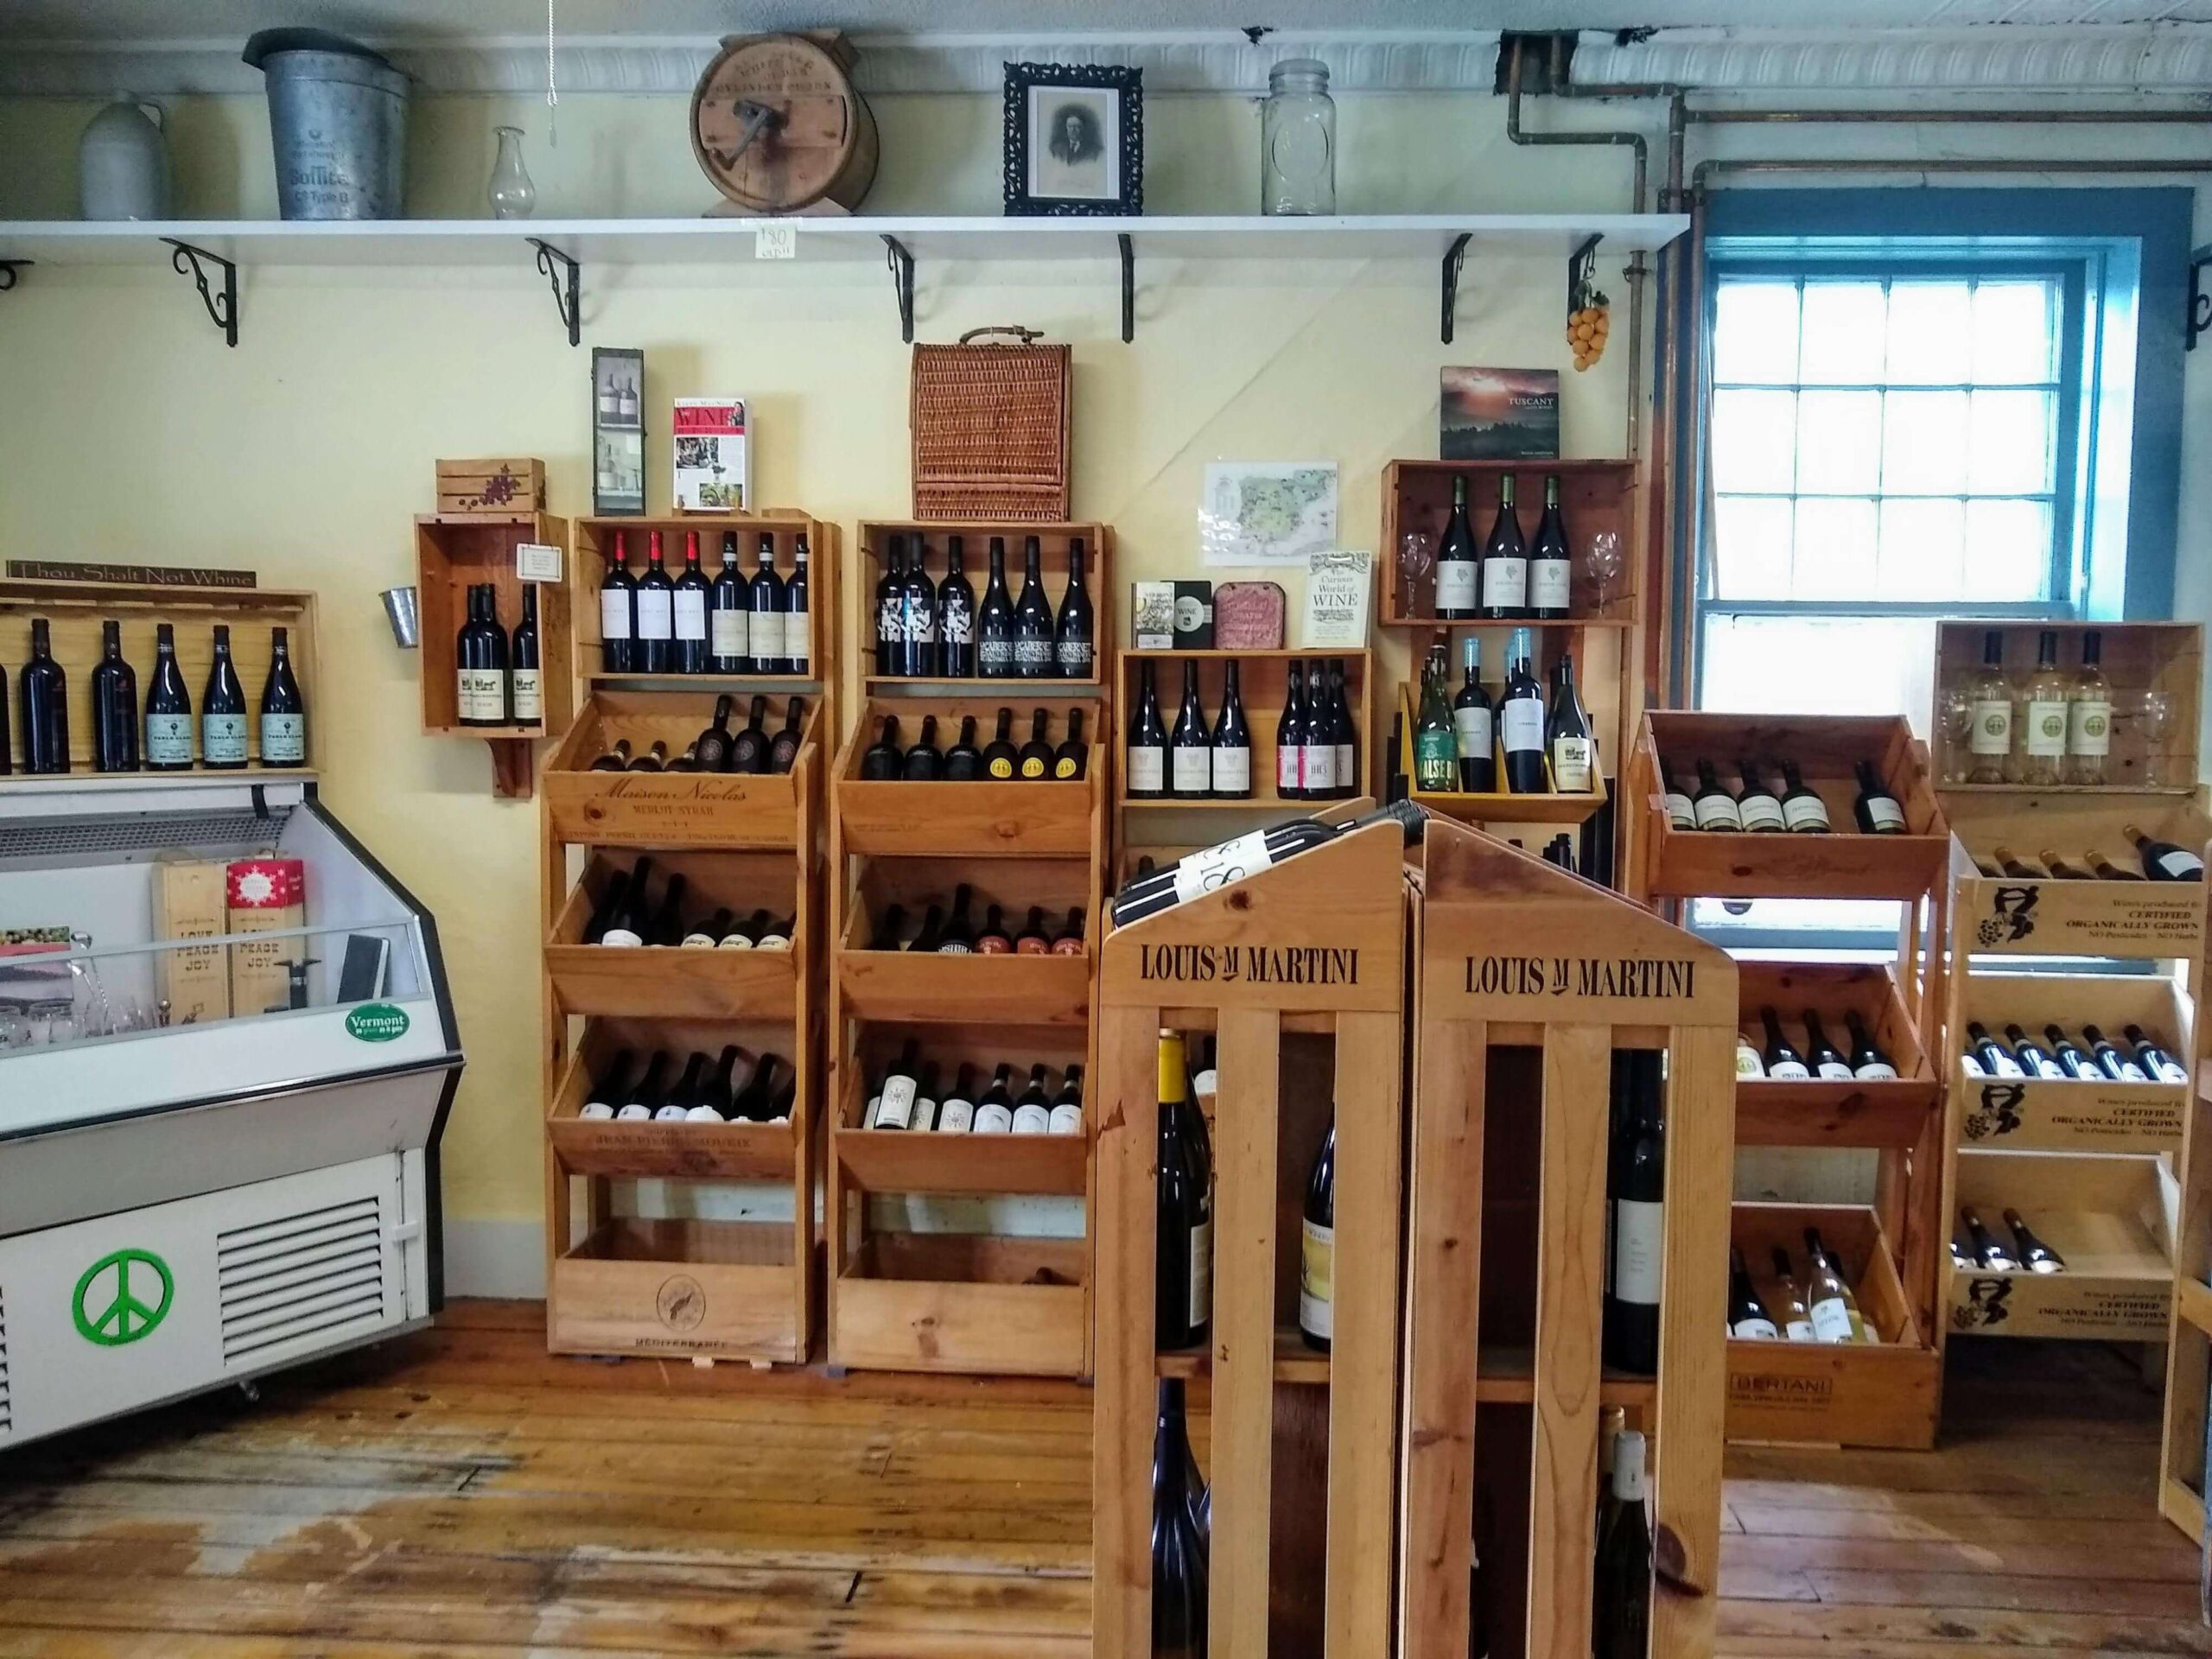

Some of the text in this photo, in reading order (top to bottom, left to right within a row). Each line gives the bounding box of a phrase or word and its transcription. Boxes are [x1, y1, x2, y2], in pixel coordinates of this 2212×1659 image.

[1509, 397, 1554, 406] TUSCANY
[18, 562, 252, 587] Thou Shalt Not Whine
[1319, 584, 1346, 593] World
[1313, 594, 1358, 606] WINE
[681, 780, 747, 801] Nicolas
[2129, 911, 2192, 919] CERTIFIED
[2066, 920, 2199, 931] ORGANICALLY GROWN
[239, 943, 279, 953] PEACE
[186, 960, 210, 971] JOY
[247, 957, 271, 967] JOY
[1141, 944, 1359, 985] LOUIS M MARTINI
[1465, 956, 1696, 999] LOUIS M MARTINI
[350, 1015, 405, 1028] Vermont
[2113, 1108, 2176, 1117] CERTIFIED
[2051, 1116, 2183, 1128] ORGANICALLY GROWN
